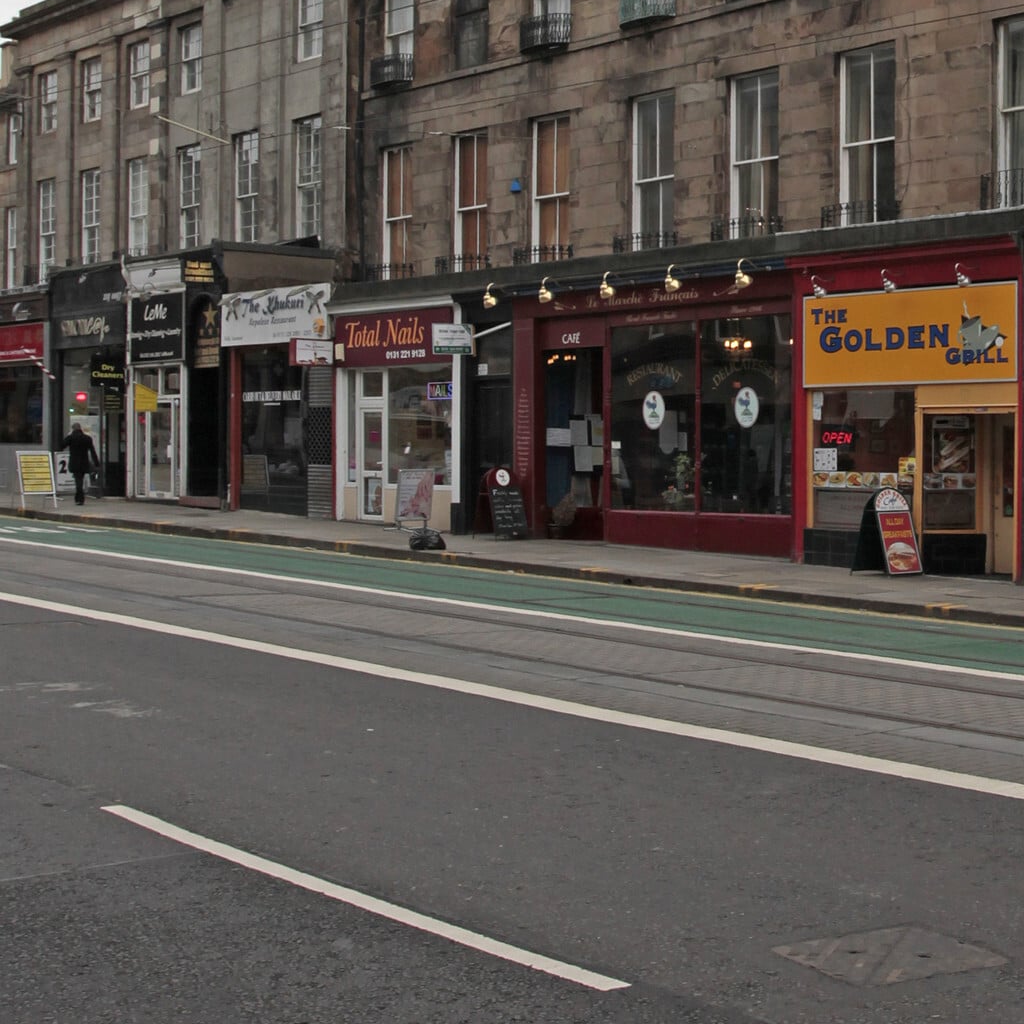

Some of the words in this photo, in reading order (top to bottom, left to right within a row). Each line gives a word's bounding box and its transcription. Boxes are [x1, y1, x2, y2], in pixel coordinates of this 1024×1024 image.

[811, 308, 848, 325] THE
[345, 320, 381, 349] Total
[383, 316, 425, 348] Nails
[561, 331, 580, 345] CAFÉ
[819, 324, 949, 353] GOLDEN
[386, 350, 400, 360] 0131
[400, 350, 411, 359] 221
[945, 348, 1009, 366] GRILL
[101, 363, 115, 372] Dry
[626, 362, 683, 386] RESTAURANT
[822, 431, 854, 446] OPEN
